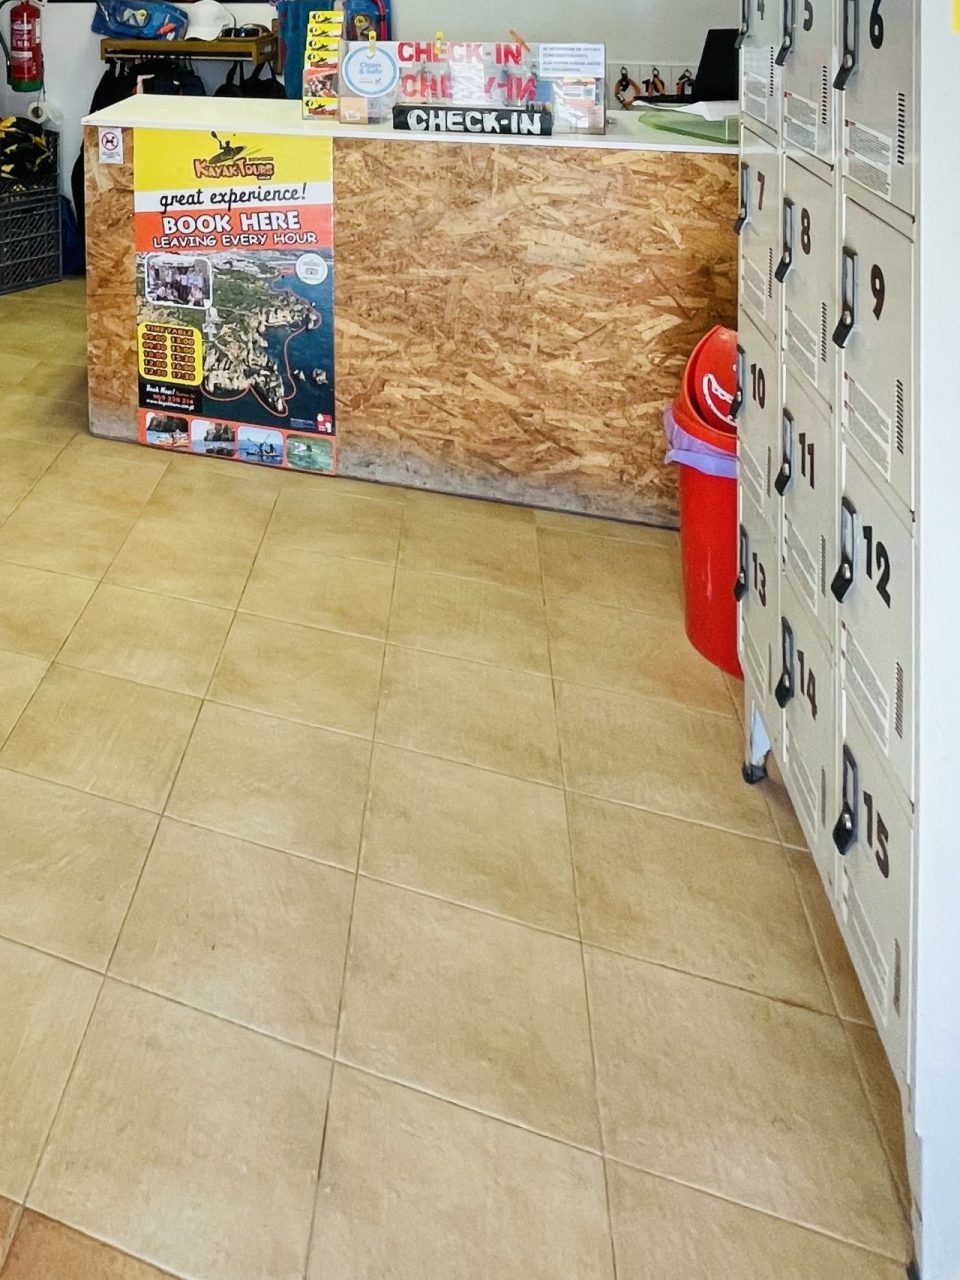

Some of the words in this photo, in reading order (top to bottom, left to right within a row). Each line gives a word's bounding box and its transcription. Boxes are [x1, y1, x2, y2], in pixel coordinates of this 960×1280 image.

[398, 42, 522, 65] CHECK-IN
[407, 109, 542, 134] CHECK-IN
[160, 188, 204, 214] great
[209, 183, 307, 212] experience!
[757, 171, 766, 211] 7
[153, 235, 217, 249] LEAVING
[222, 233, 268, 247] EVERY
[273, 231, 318, 245] HOUR
[162, 214, 232, 235] BOOK
[239, 210, 301, 231] HERE
[801, 208, 810, 255] 8
[871, 264, 885, 320] 9
[751, 364, 765, 409] 10
[799, 433, 814, 489] 11
[753, 552, 766, 607] 13
[863, 526, 890, 608] 12
[797, 650, 817, 720] 14
[864, 791, 889, 878] 15
